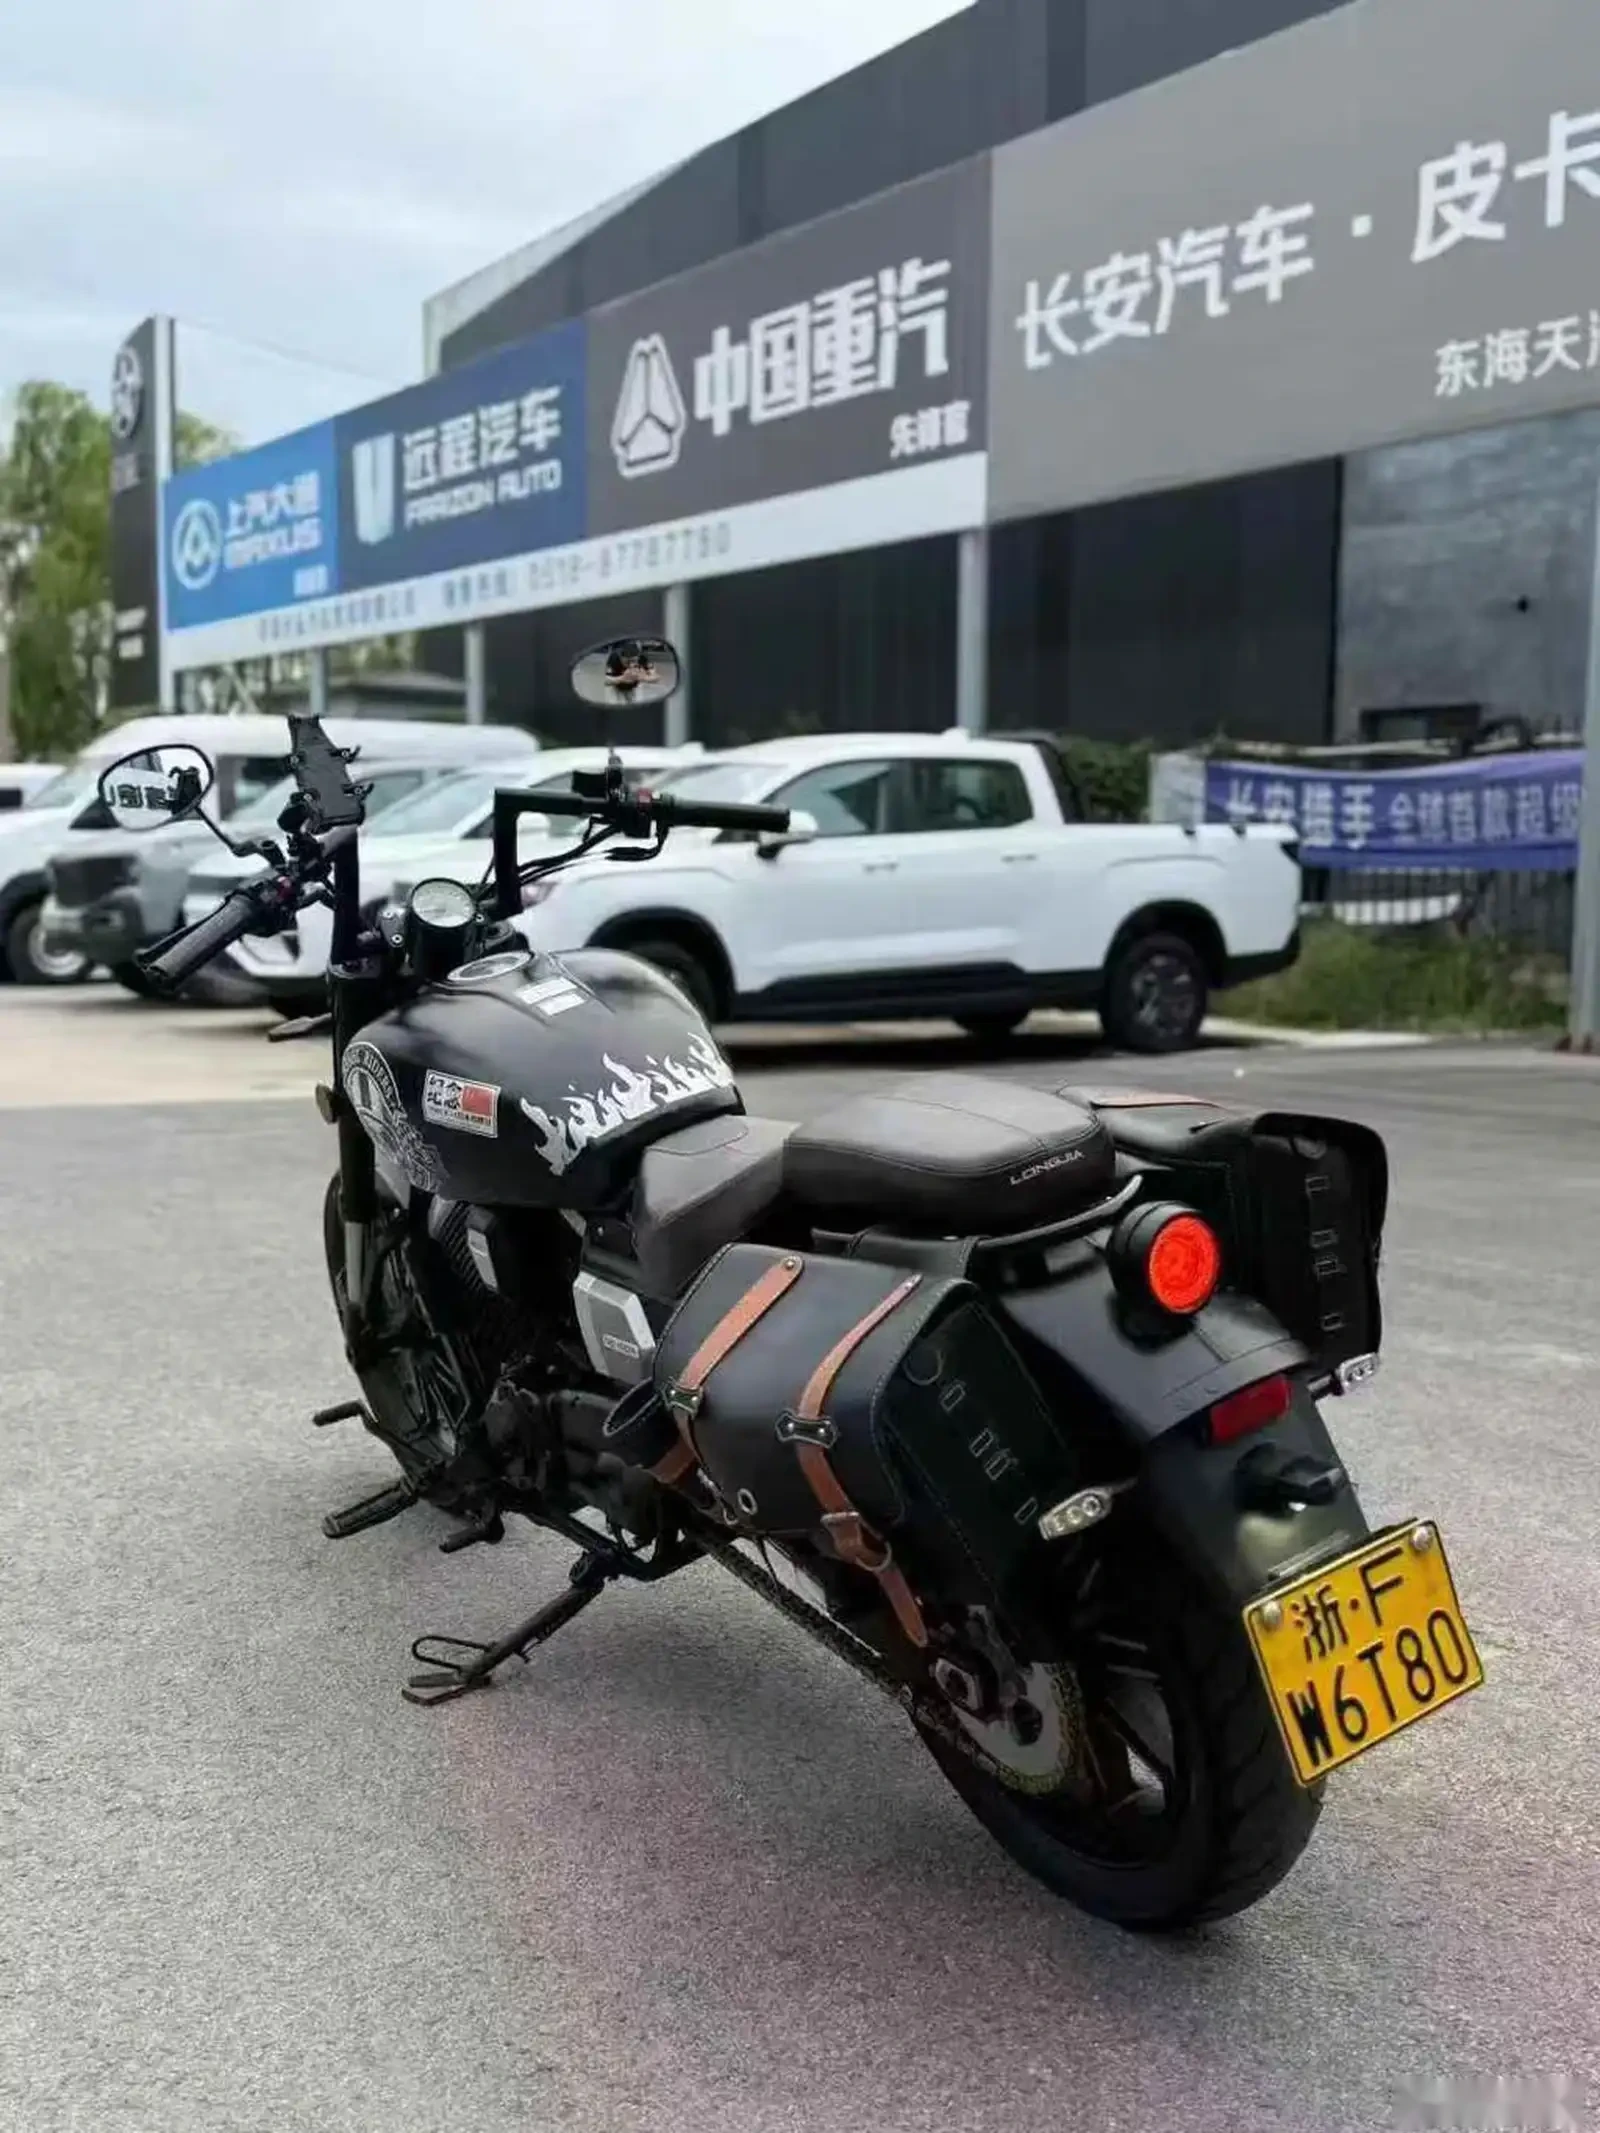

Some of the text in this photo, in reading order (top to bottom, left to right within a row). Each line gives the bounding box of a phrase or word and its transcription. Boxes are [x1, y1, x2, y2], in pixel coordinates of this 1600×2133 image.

[693, 257, 952, 437] 中国重汽
[402, 385, 562, 493] 远程汽车
[497, 458, 563, 504] AUTO
[1009, 1149, 1085, 1187] LONGJIA
[1286, 1608, 1469, 1768] W6T80
